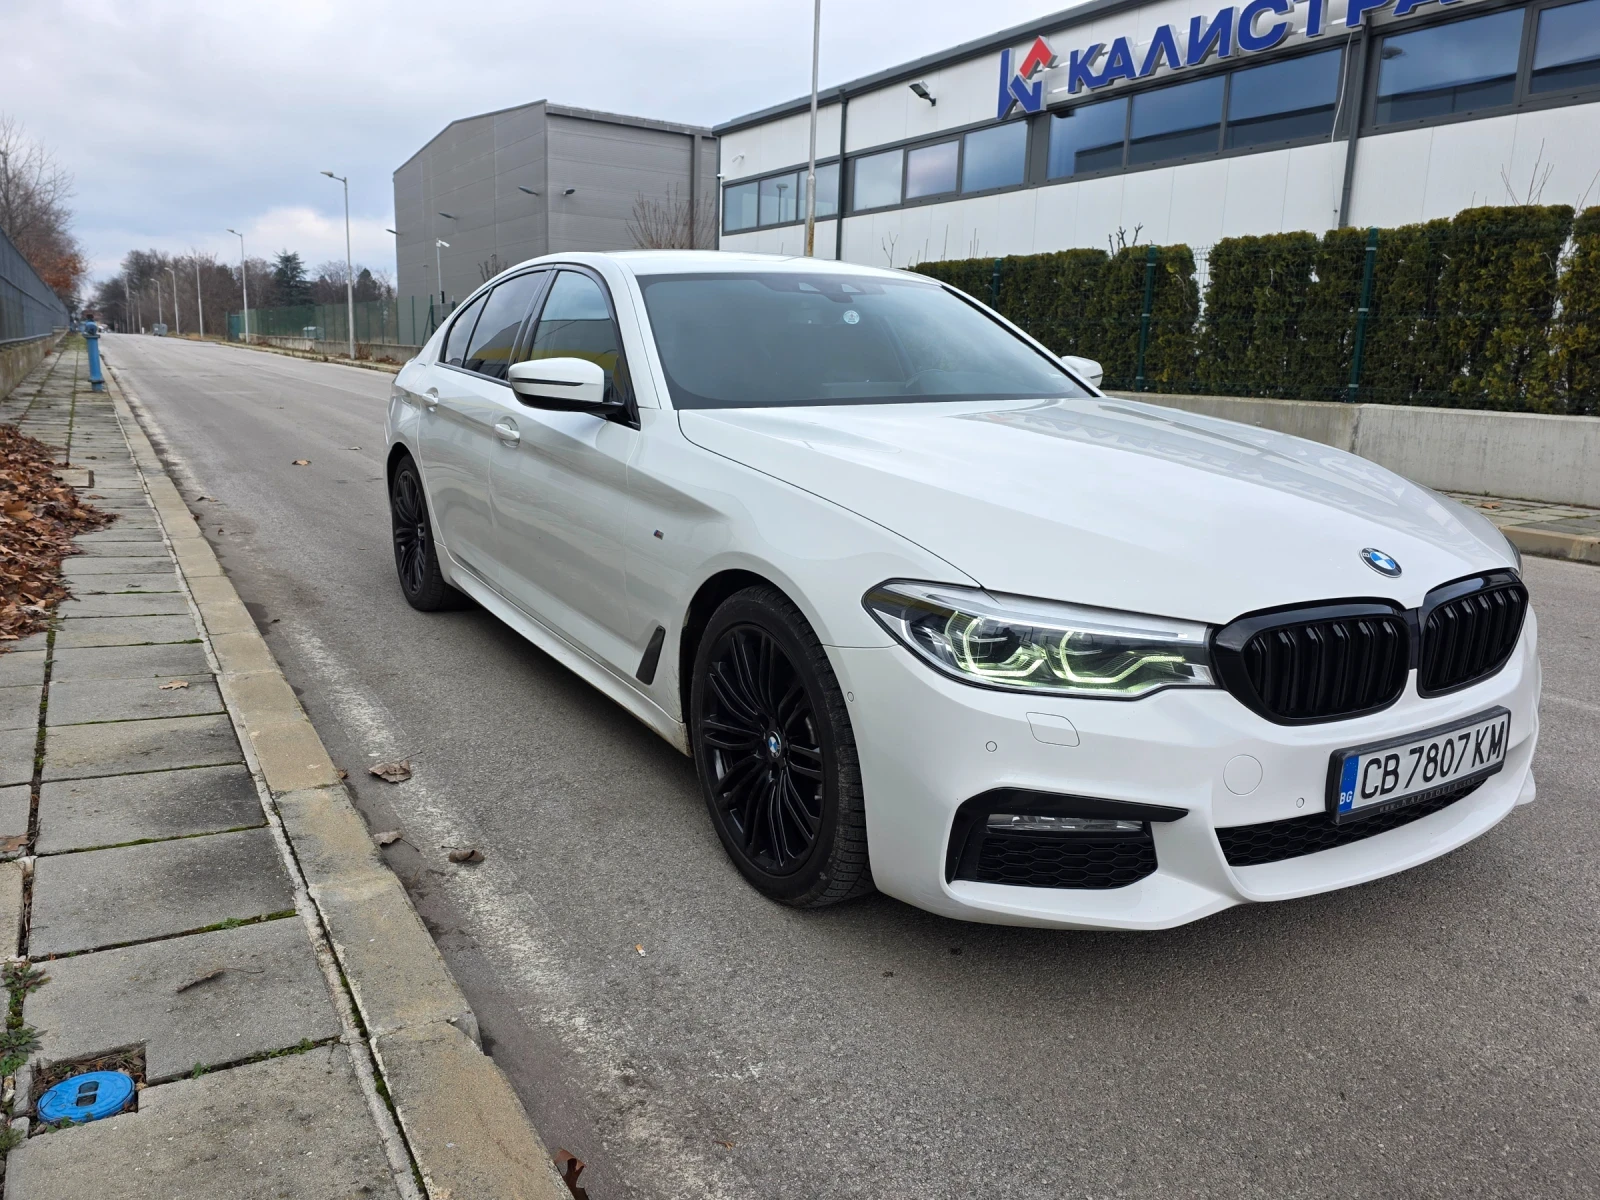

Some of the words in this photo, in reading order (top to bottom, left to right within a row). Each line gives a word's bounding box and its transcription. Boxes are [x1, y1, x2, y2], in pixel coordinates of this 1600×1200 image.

[1067, 0, 1464, 94] КАЛИСТР
[1339, 790, 1353, 805] BG
[1361, 753, 1400, 800] CB
[1404, 732, 1471, 789] 7807
[1471, 721, 1505, 768] KM
